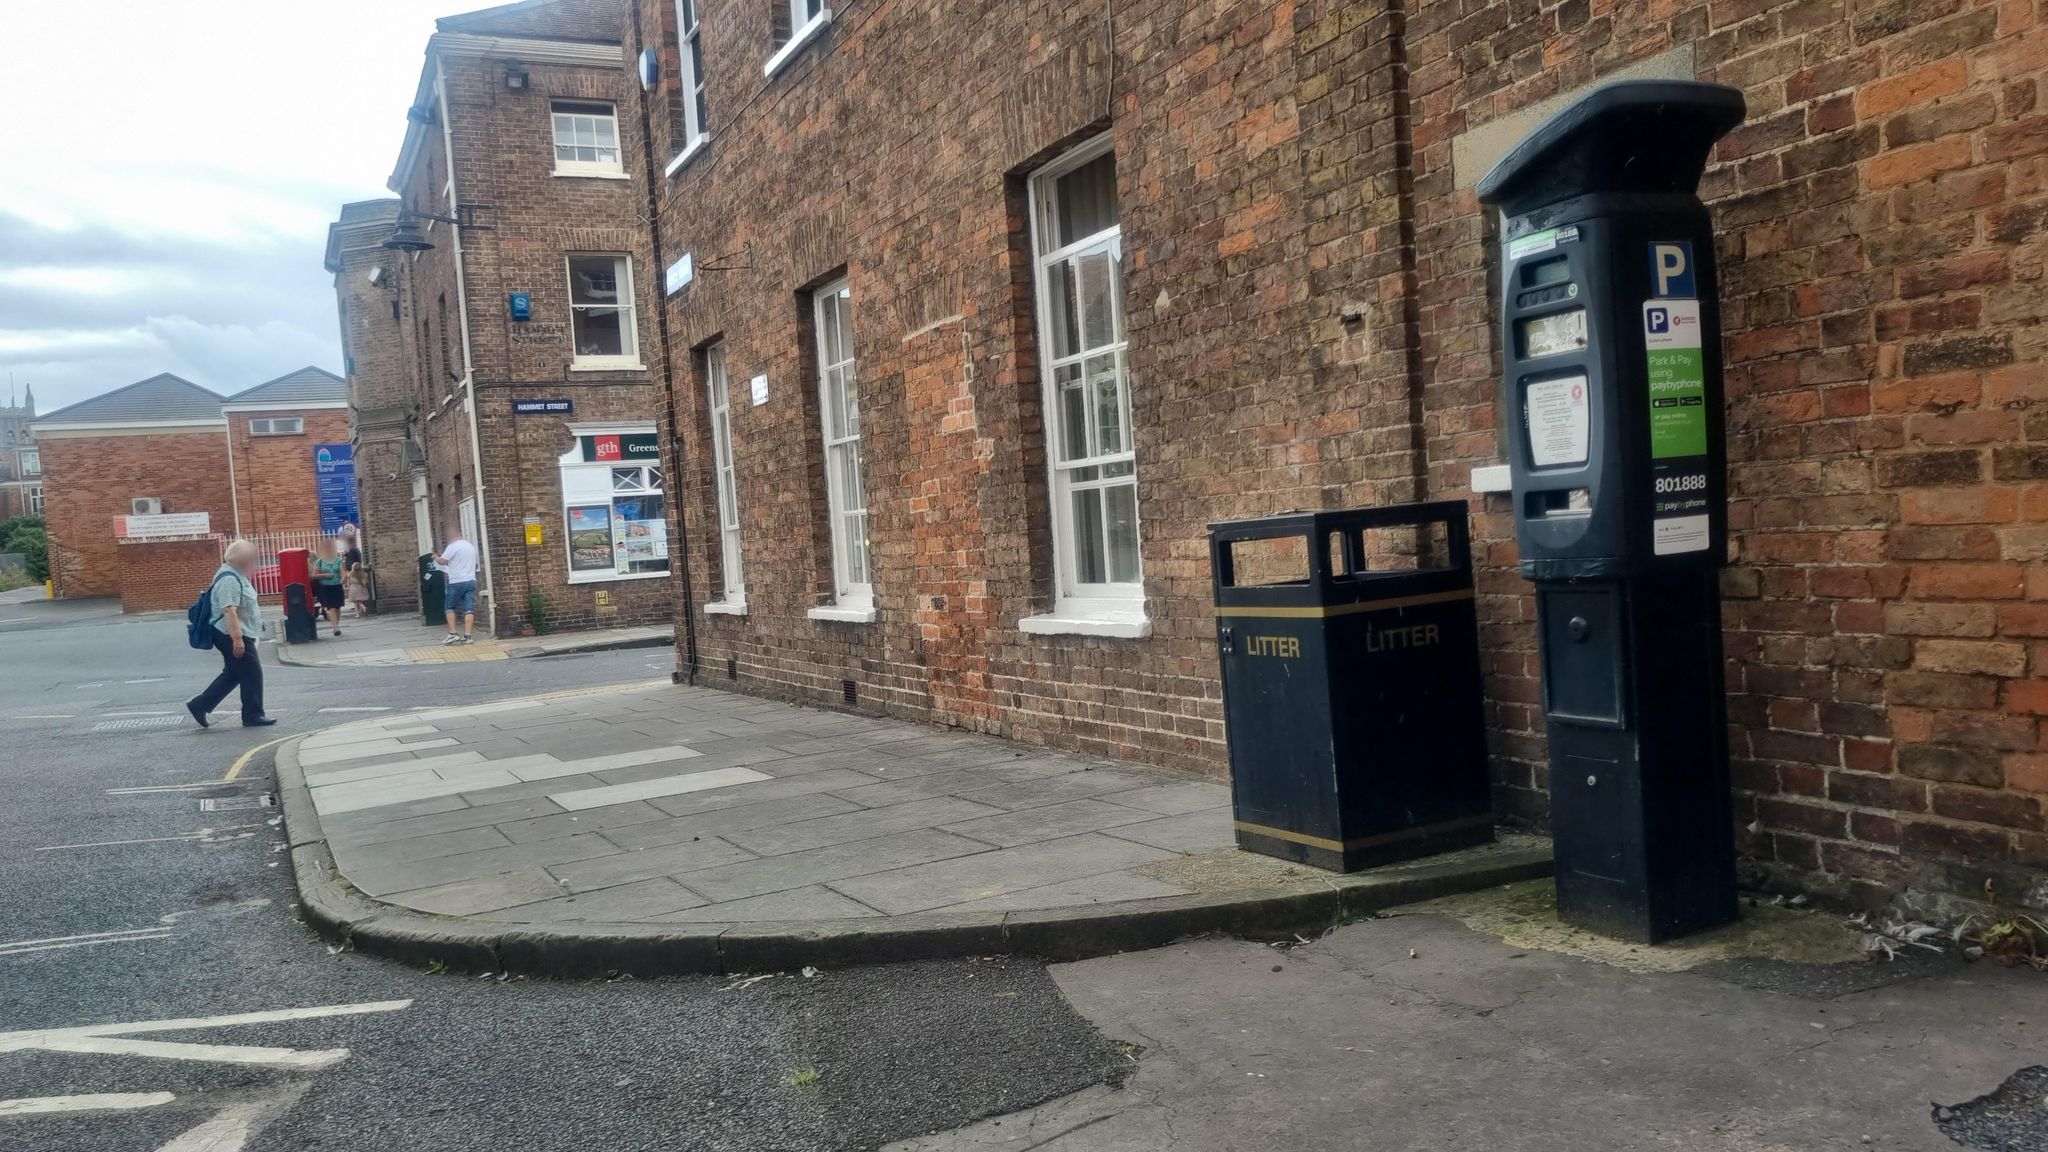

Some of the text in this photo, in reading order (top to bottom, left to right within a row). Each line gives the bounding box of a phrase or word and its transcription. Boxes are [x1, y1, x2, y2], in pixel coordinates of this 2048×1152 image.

[1655, 245, 1686, 295] P
[1651, 311, 1665, 330] P
[1649, 354, 1692, 367] Park & Pay
[1650, 369, 1673, 379] using
[1651, 379, 1702, 391] paybyphone
[517, 402, 569, 411] HAMMET STREET
[596, 441, 618, 457] gth
[1655, 474, 1706, 493] 801888
[1664, 499, 1707, 511] paybyphone
[1367, 624, 1440, 653] LITTER
[1247, 636, 1301, 658] LITTER
